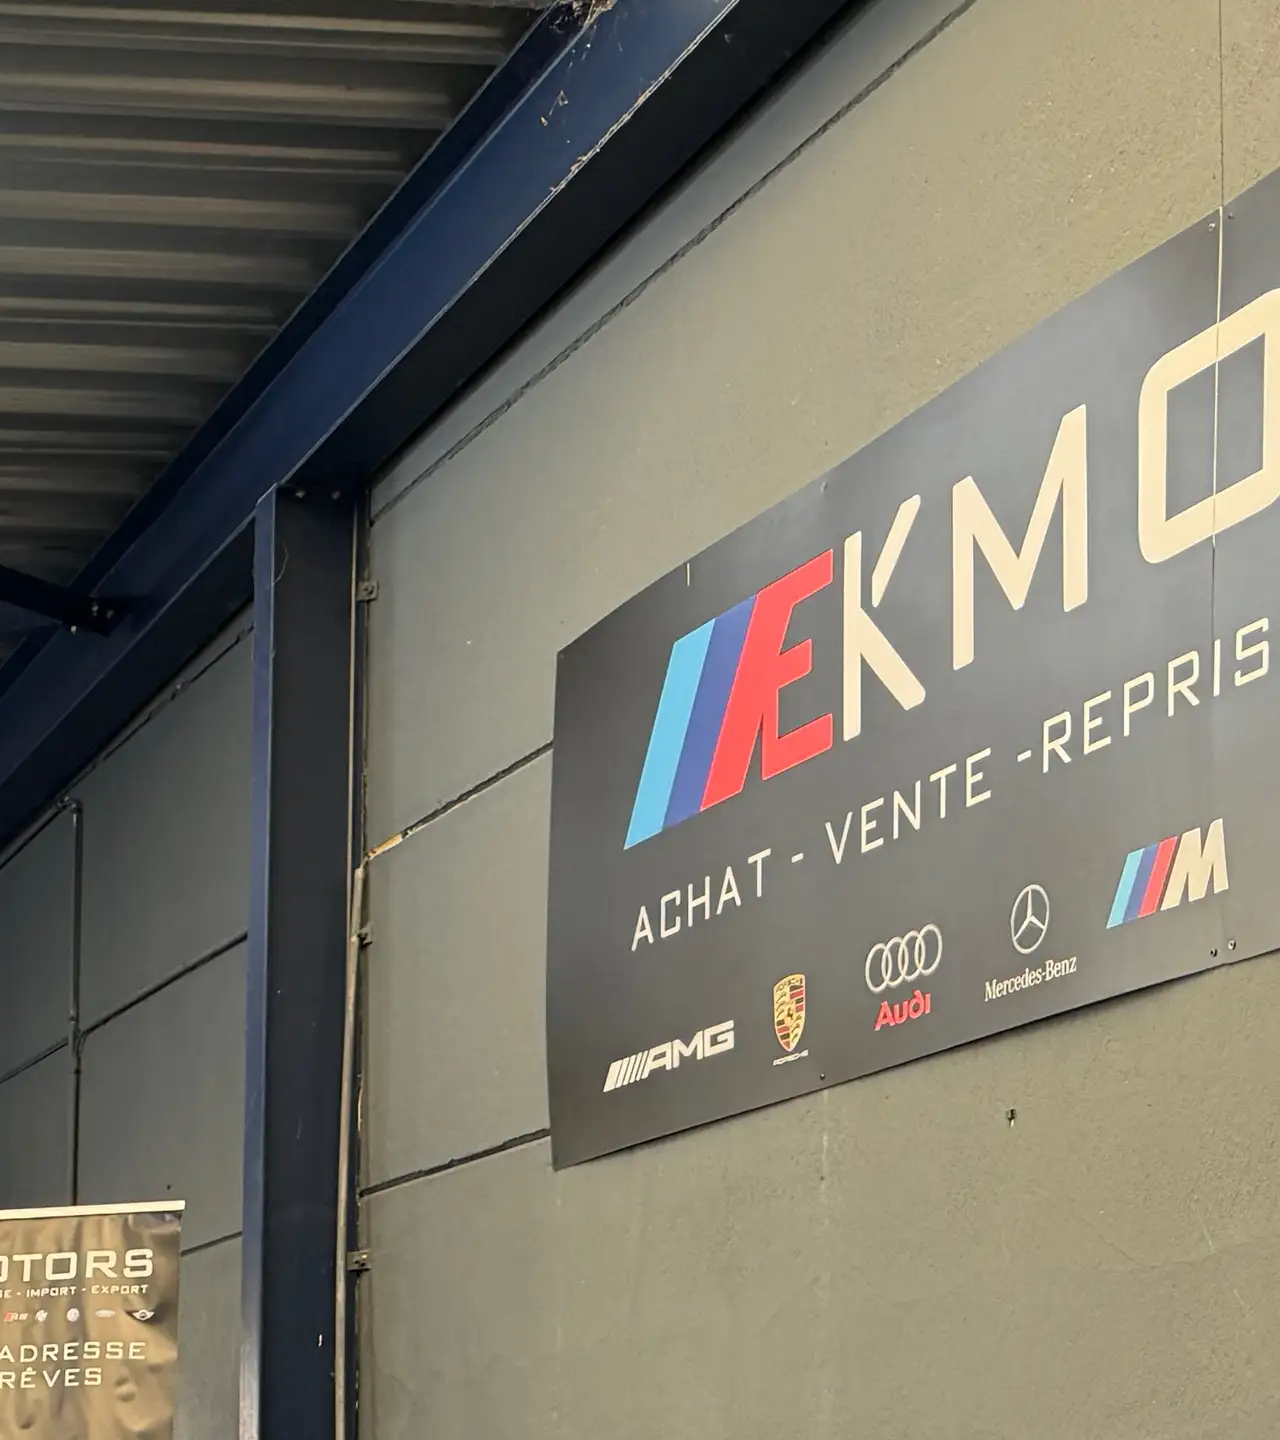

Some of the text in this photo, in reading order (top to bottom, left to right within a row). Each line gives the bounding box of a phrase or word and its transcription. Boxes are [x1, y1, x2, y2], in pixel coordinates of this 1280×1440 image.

[631, 849, 772, 951] ACHAT
[825, 748, 992, 864] VENTE
[984, 956, 1077, 1002] Mercedes-Benz
[874, 989, 932, 1031] Audi
[26, 1286, 77, 1298] IMPORT
[91, 1284, 149, 1295] EXPORT
